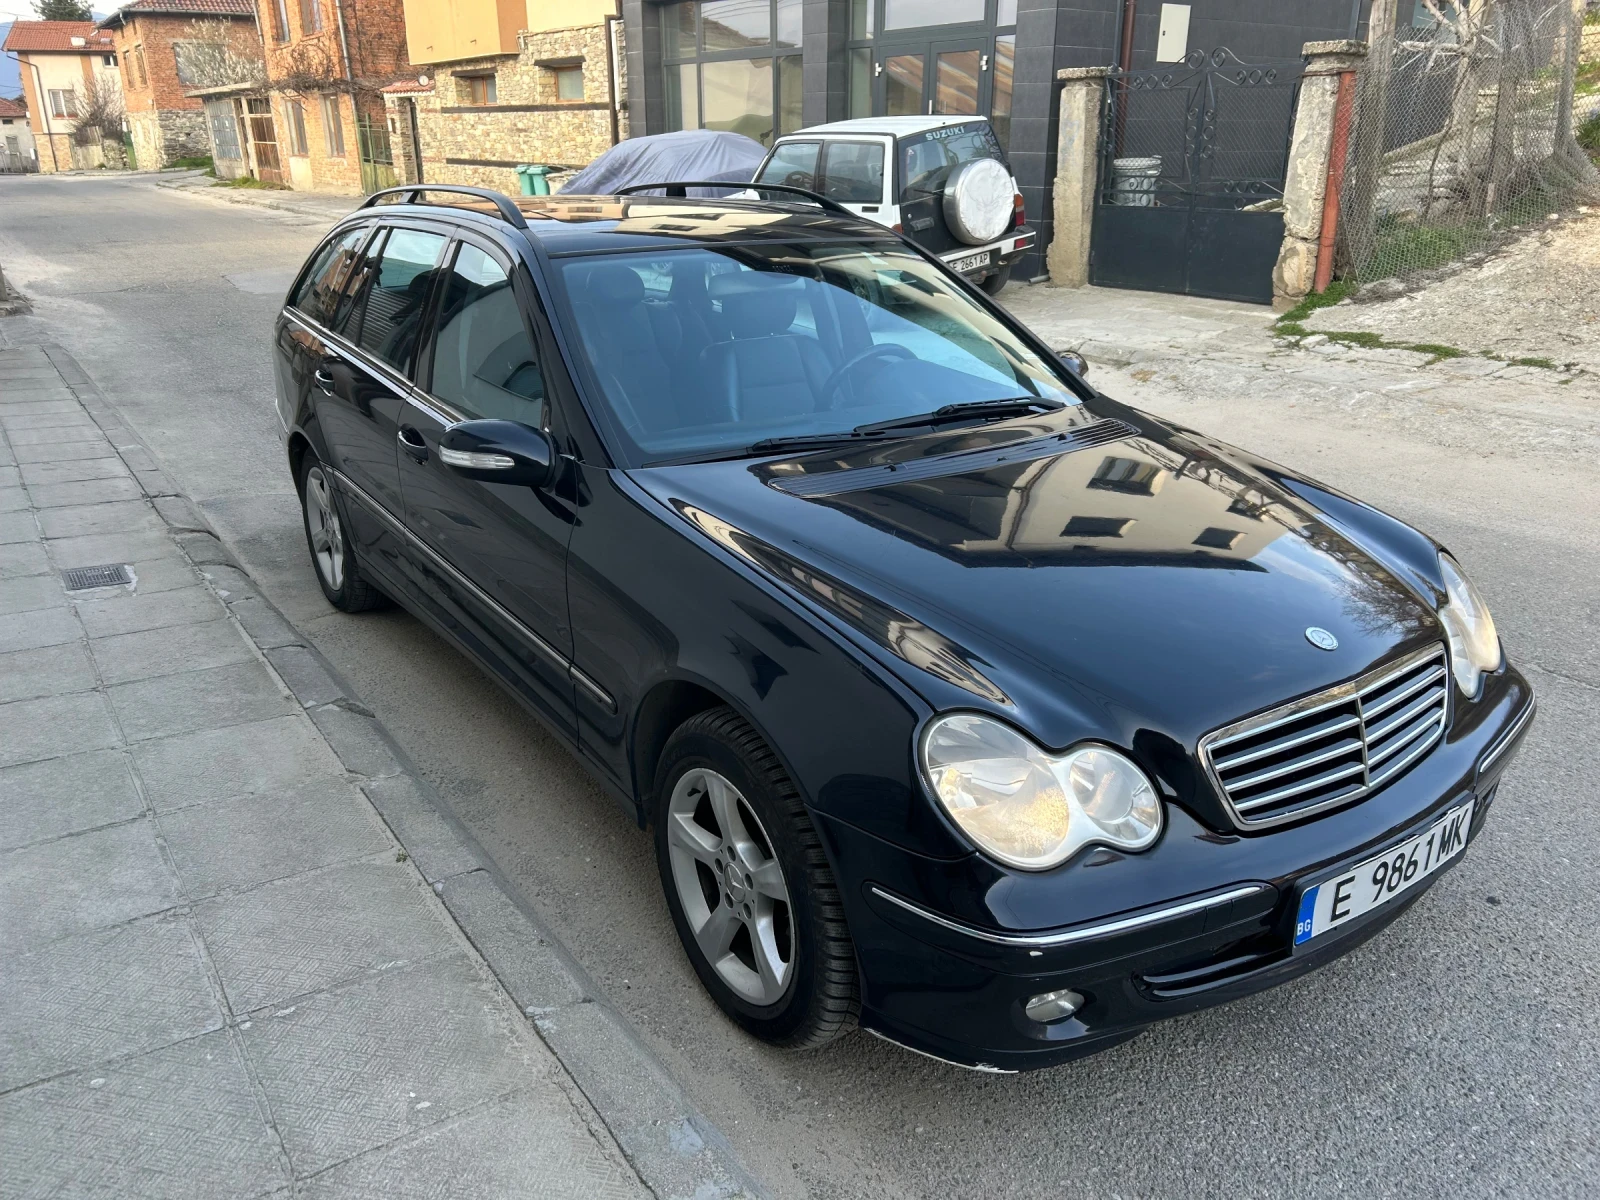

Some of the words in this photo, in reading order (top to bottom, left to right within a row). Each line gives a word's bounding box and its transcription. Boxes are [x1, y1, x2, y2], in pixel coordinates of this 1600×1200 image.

[925, 126, 965, 141] SUZUKI
[960, 257, 978, 270] 2661
[978, 253, 988, 265] AP
[1330, 875, 1356, 923] E
[1296, 918, 1312, 936] BG
